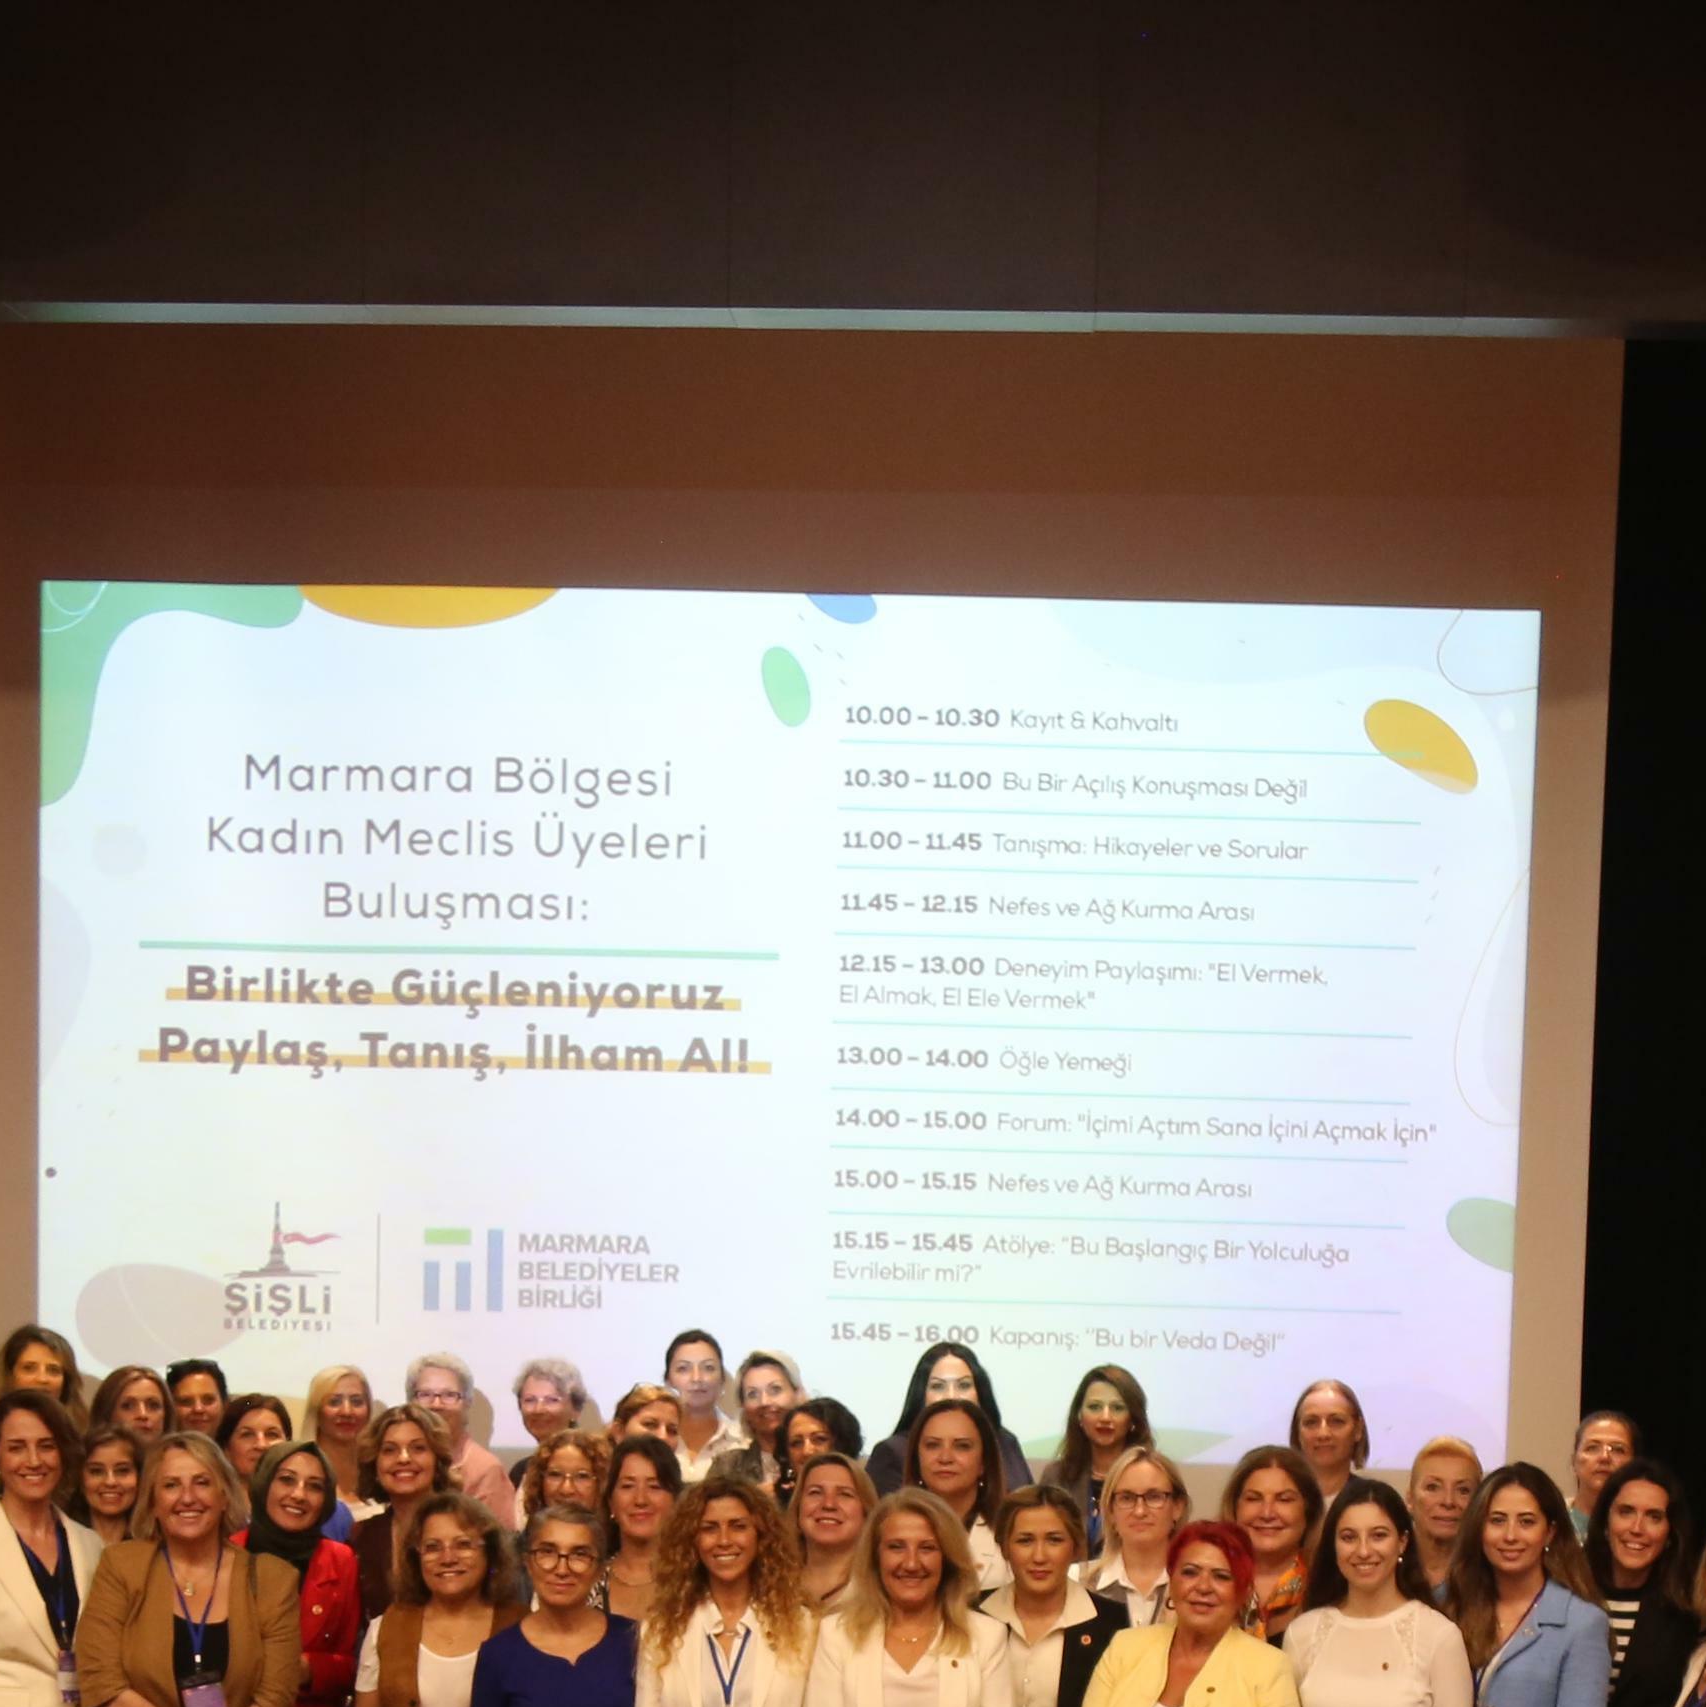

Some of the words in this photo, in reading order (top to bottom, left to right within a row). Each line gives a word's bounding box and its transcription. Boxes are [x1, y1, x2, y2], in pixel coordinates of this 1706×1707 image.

[846, 705, 913, 728] 10.00
[936, 708, 1002, 729] 10.30
[1011, 710, 1065, 735] Kayıt
[1071, 711, 1086, 731] &
[1093, 712, 1179, 733] Kahvaltı
[246, 754, 474, 794] Marmara
[495, 757, 673, 808] Bölgesi
[845, 768, 911, 790] 10.30
[933, 771, 993, 792] 11.00
[1003, 772, 1033, 792] Bu
[1038, 773, 1069, 793] Bir
[1072, 774, 1128, 801] Açılış
[1133, 776, 1250, 802] Konuşması
[1255, 778, 1309, 807] Değil
[208, 816, 345, 856] Kadın
[366, 819, 515, 858] Meclis
[535, 814, 707, 870] Üyeleri
[843, 831, 904, 853] 11.00
[926, 832, 984, 854] 11.45
[993, 833, 1089, 861] Tanışma:
[1094, 837, 1195, 863] Hikayeler
[1197, 843, 1224, 859] ve
[1228, 839, 1310, 862] Sorular
[324, 881, 589, 932] Buluşması:
[842, 893, 900, 914] 11.45
[922, 894, 980, 915] 12.15
[989, 896, 1052, 919] Nefes
[1056, 903, 1082, 918] ve
[1085, 898, 1117, 926] Ağ
[1122, 899, 1195, 921] Kurma
[1198, 901, 1256, 923] Arası
[840, 954, 898, 975] 12.15
[920, 956, 987, 978] 13.00
[995, 957, 1090, 985] Deneyim
[1095, 960, 1204, 988] Paylaşımı:
[1240, 963, 1330, 988] Vermek,
[184, 965, 376, 1007] Birlikte
[392, 968, 726, 1019] Güçleniyoruz
[840, 984, 860, 1006] El
[863, 985, 938, 1009] Almak,
[943, 987, 963, 1008] El
[968, 987, 1002, 1009] Ele
[158, 1027, 345, 1076] Paylaş,
[359, 1032, 509, 1079] Tanış,
[526, 1027, 665, 1074] İlham
[678, 1037, 750, 1076] Al!
[838, 1046, 904, 1068] 13.00
[926, 1049, 990, 1070] 14.00
[1000, 1046, 1051, 1078] Öğle
[1055, 1052, 1133, 1081] Yemeği
[836, 1108, 902, 1131] 14.00
[923, 1110, 989, 1133] 15.00
[998, 1112, 1073, 1134] Forum:
[1137, 1115, 1202, 1143] Açtım
[1206, 1116, 1264, 1140] Sana
[1268, 1113, 1310, 1146] İçini
[1312, 1118, 1389, 1148] Açmak
[835, 1169, 900, 1191] 15.00
[922, 1171, 979, 1193] 15.15
[988, 1173, 1051, 1195] Nefes
[1054, 1179, 1081, 1195] ve
[1083, 1175, 1115, 1203] Ağ
[1120, 1176, 1193, 1198] Kurma
[1195, 1178, 1254, 1200] Arası
[520, 1234, 651, 1256] MARMARA
[833, 1230, 891, 1253] 15.15
[912, 1232, 975, 1254] 15.45
[983, 1234, 1056, 1261] Atölye:
[1105, 1236, 1210, 1266] Başlangıç
[1214, 1239, 1247, 1261] Bir
[1247, 1240, 1351, 1271] Yolculuğa
[519, 1259, 681, 1284] BELEDİYELER
[833, 1259, 933, 1282] Evrilebilir
[519, 1286, 603, 1311] BİRLİĞİ
[831, 1322, 891, 1341] 15.45
[915, 1325, 979, 1344] 16.00
[990, 1326, 1079, 1351] Kapanış:
[1130, 1330, 1158, 1347] bir
[1162, 1331, 1217, 1350] Veda
